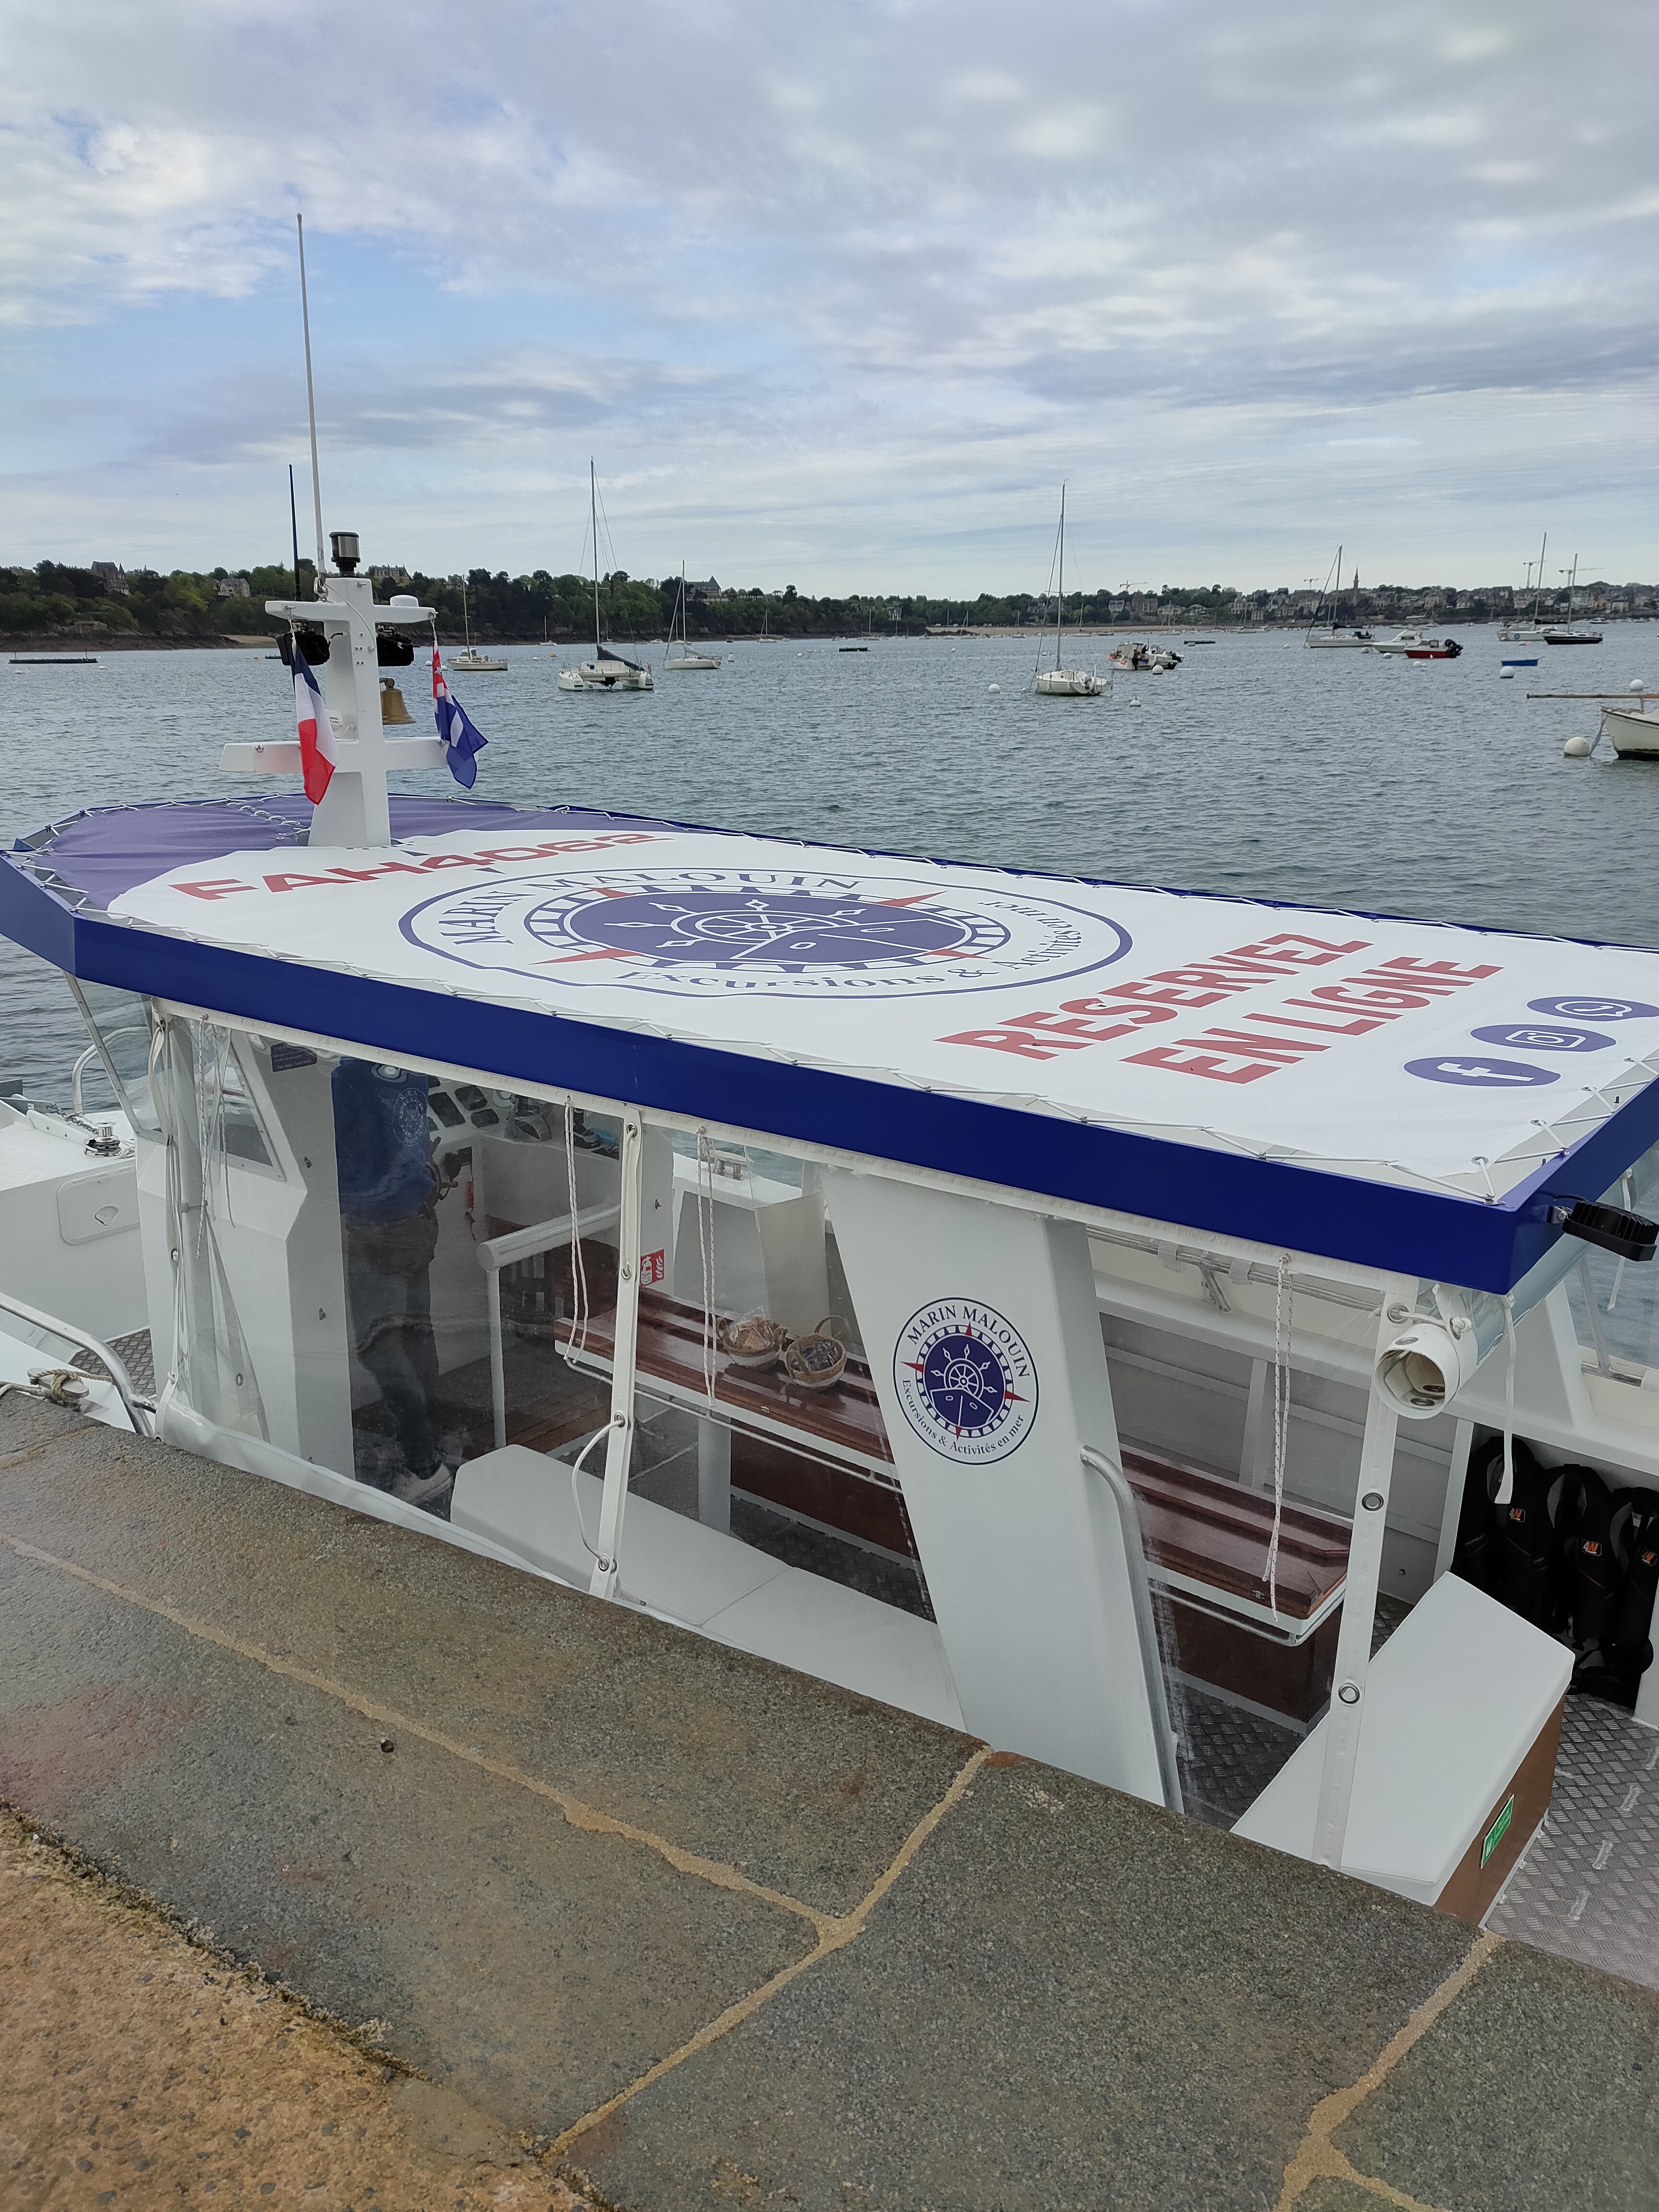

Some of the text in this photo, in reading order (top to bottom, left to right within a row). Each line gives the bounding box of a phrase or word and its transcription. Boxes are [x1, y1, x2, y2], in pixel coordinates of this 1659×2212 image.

[439, 872, 864, 945] MARIN MALOUIN
[612, 902, 1082, 988] Excursions & Activités en mer
[932, 933, 1374, 1060] RESERVEZ
[1118, 957, 1505, 1084] EN LIGNE
[907, 1305, 1030, 1378] MARIN MALOUIN
[902, 1380, 1024, 1455] Excursions & Activités en mer
